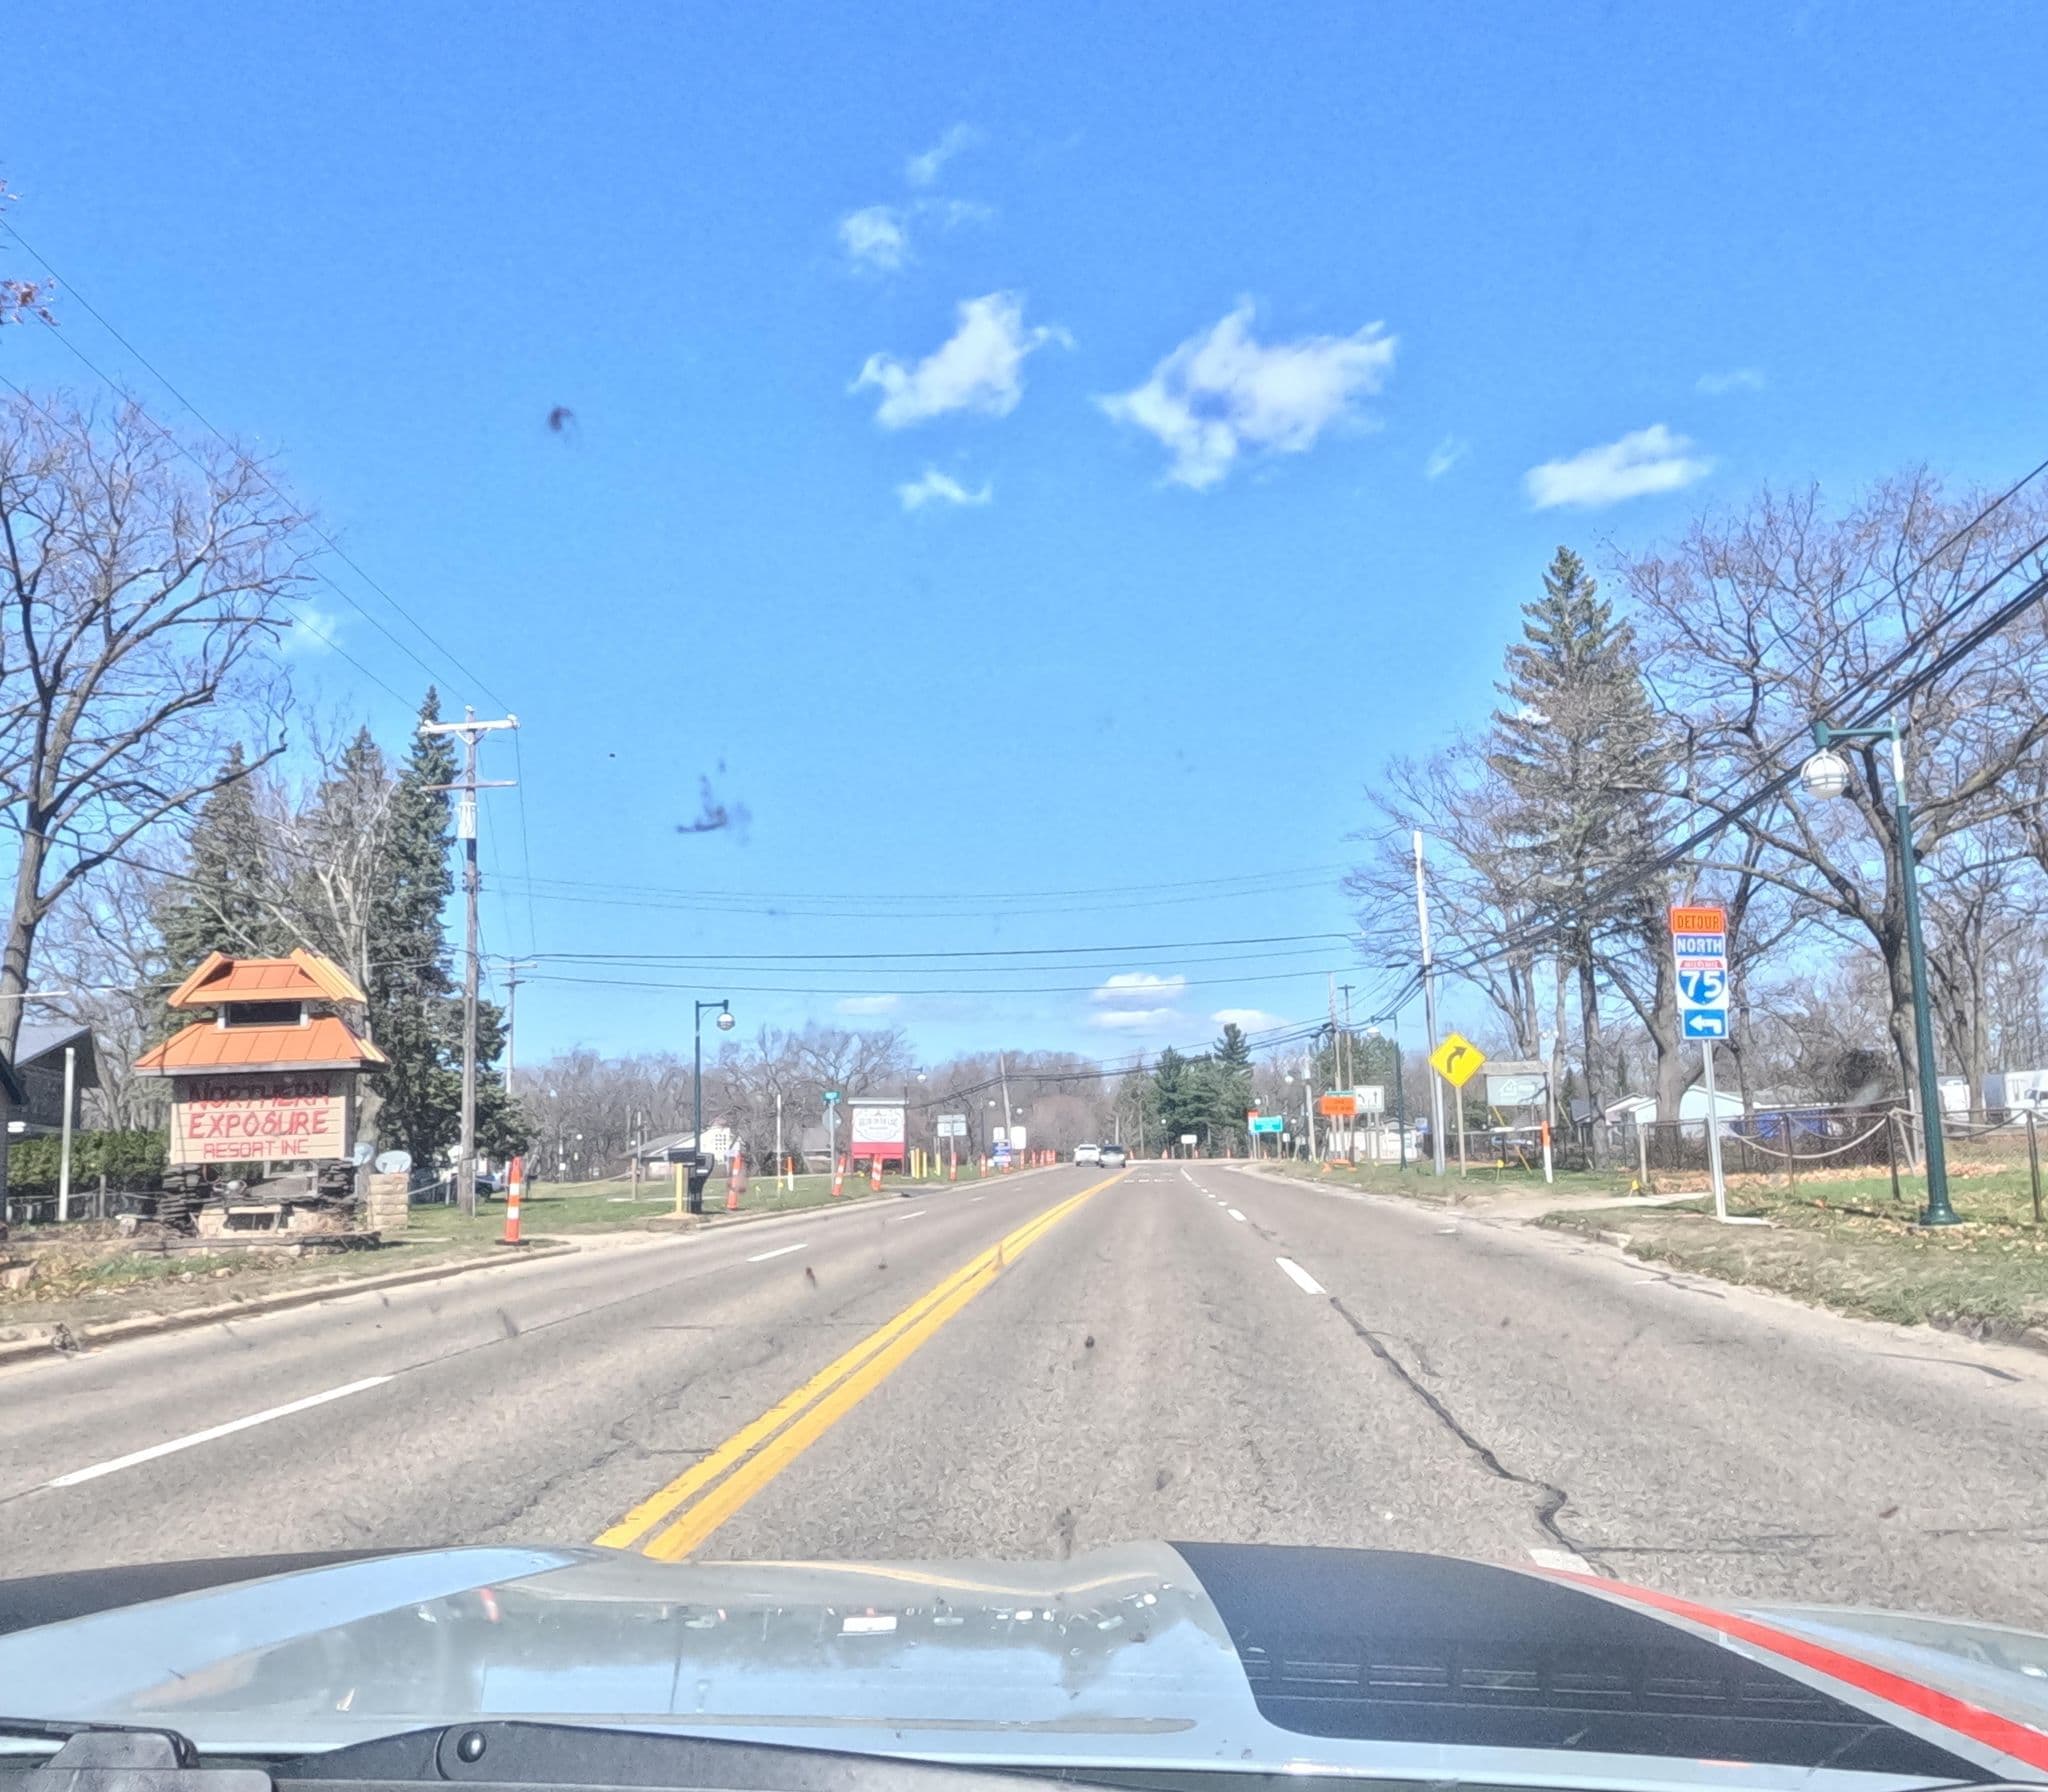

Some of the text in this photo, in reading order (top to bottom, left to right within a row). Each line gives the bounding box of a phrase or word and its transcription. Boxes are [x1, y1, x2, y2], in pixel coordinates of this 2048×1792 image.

[1677, 914, 1719, 930] DETOUR
[1677, 937, 1722, 953] NORTH
[1680, 970, 1722, 999] 75
[188, 1080, 330, 1110] NORTHERN
[188, 1110, 329, 1139] EXPOSURE
[203, 1139, 309, 1159] RESORT INC
